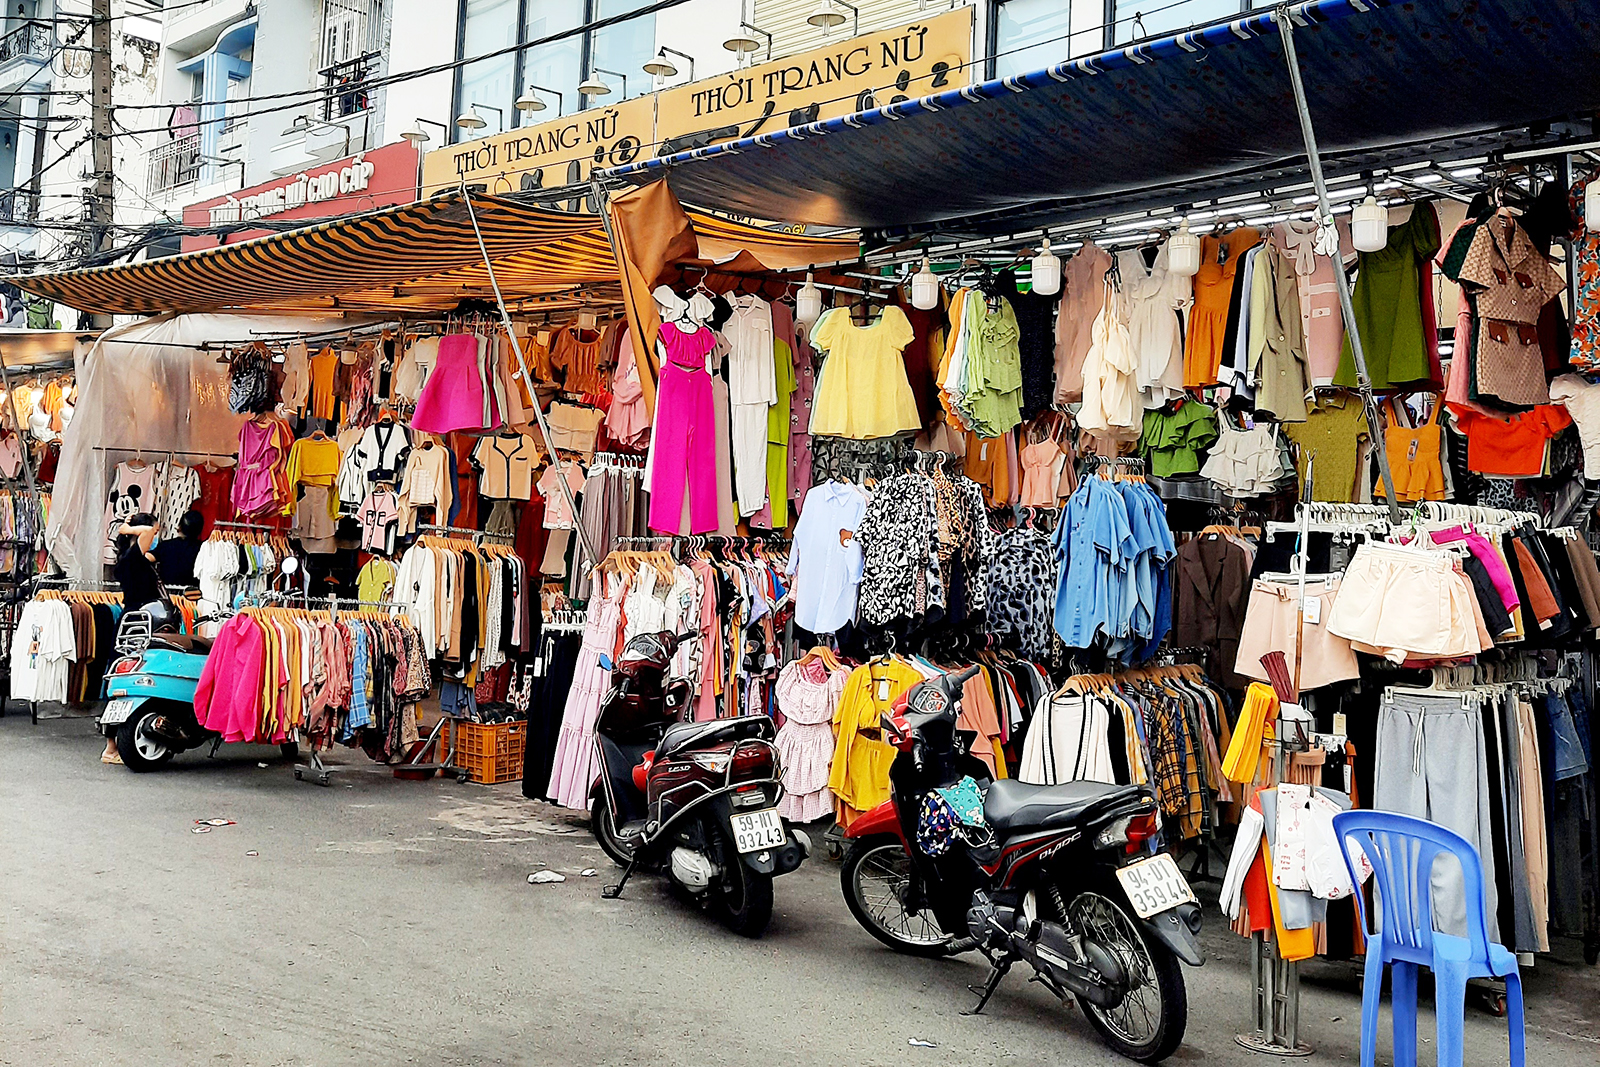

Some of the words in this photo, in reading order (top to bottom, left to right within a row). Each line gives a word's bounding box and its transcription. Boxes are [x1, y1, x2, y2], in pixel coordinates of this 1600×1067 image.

[691, 75, 753, 117] THỜI
[763, 46, 873, 98] TRANG
[880, 25, 928, 68] NỮ
[454, 141, 498, 174] THỜI
[504, 124, 581, 163] TRANG
[586, 109, 619, 143] NỮ
[307, 171, 339, 201] CAO
[739, 812, 773, 831] 59-N1
[739, 828, 783, 849] 932.43
[1134, 879, 1188, 912] 359.44
